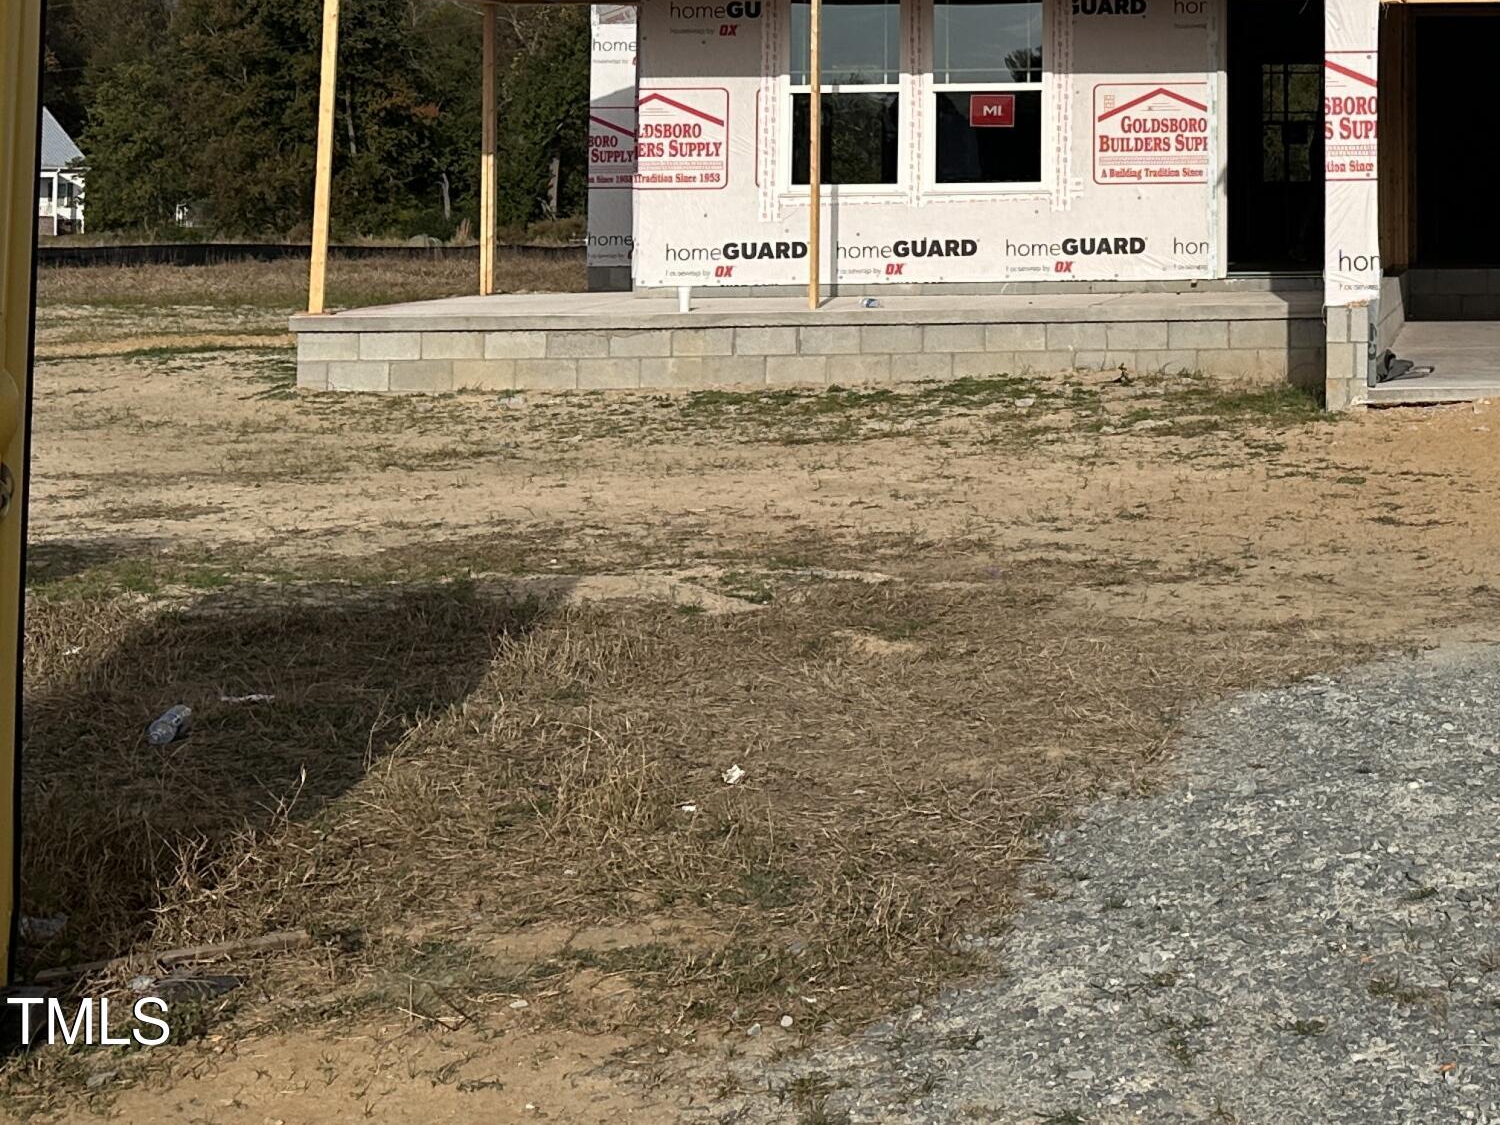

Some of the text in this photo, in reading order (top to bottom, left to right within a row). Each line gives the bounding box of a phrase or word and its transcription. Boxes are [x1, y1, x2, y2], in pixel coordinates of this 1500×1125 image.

[719, 24, 739, 37] OX
[1121, 116, 1207, 133] GOLDSBORO
[668, 139, 722, 157] SUPPLY
[1099, 134, 1171, 152] BUILDERS
[591, 148, 634, 163] SUPPLY
[1349, 160, 1374, 173] Since
[675, 173, 697, 183] Since
[699, 173, 720, 183] 1953
[1101, 167, 1203, 181] A Building Tradition Since
[665, 241, 808, 262] homeGUARD
[836, 238, 978, 259] homeGUARD
[1005, 237, 1146, 257] homeGUARD
[714, 265, 735, 278] OX
[885, 263, 905, 275] OX
[1054, 261, 1073, 273] OX
